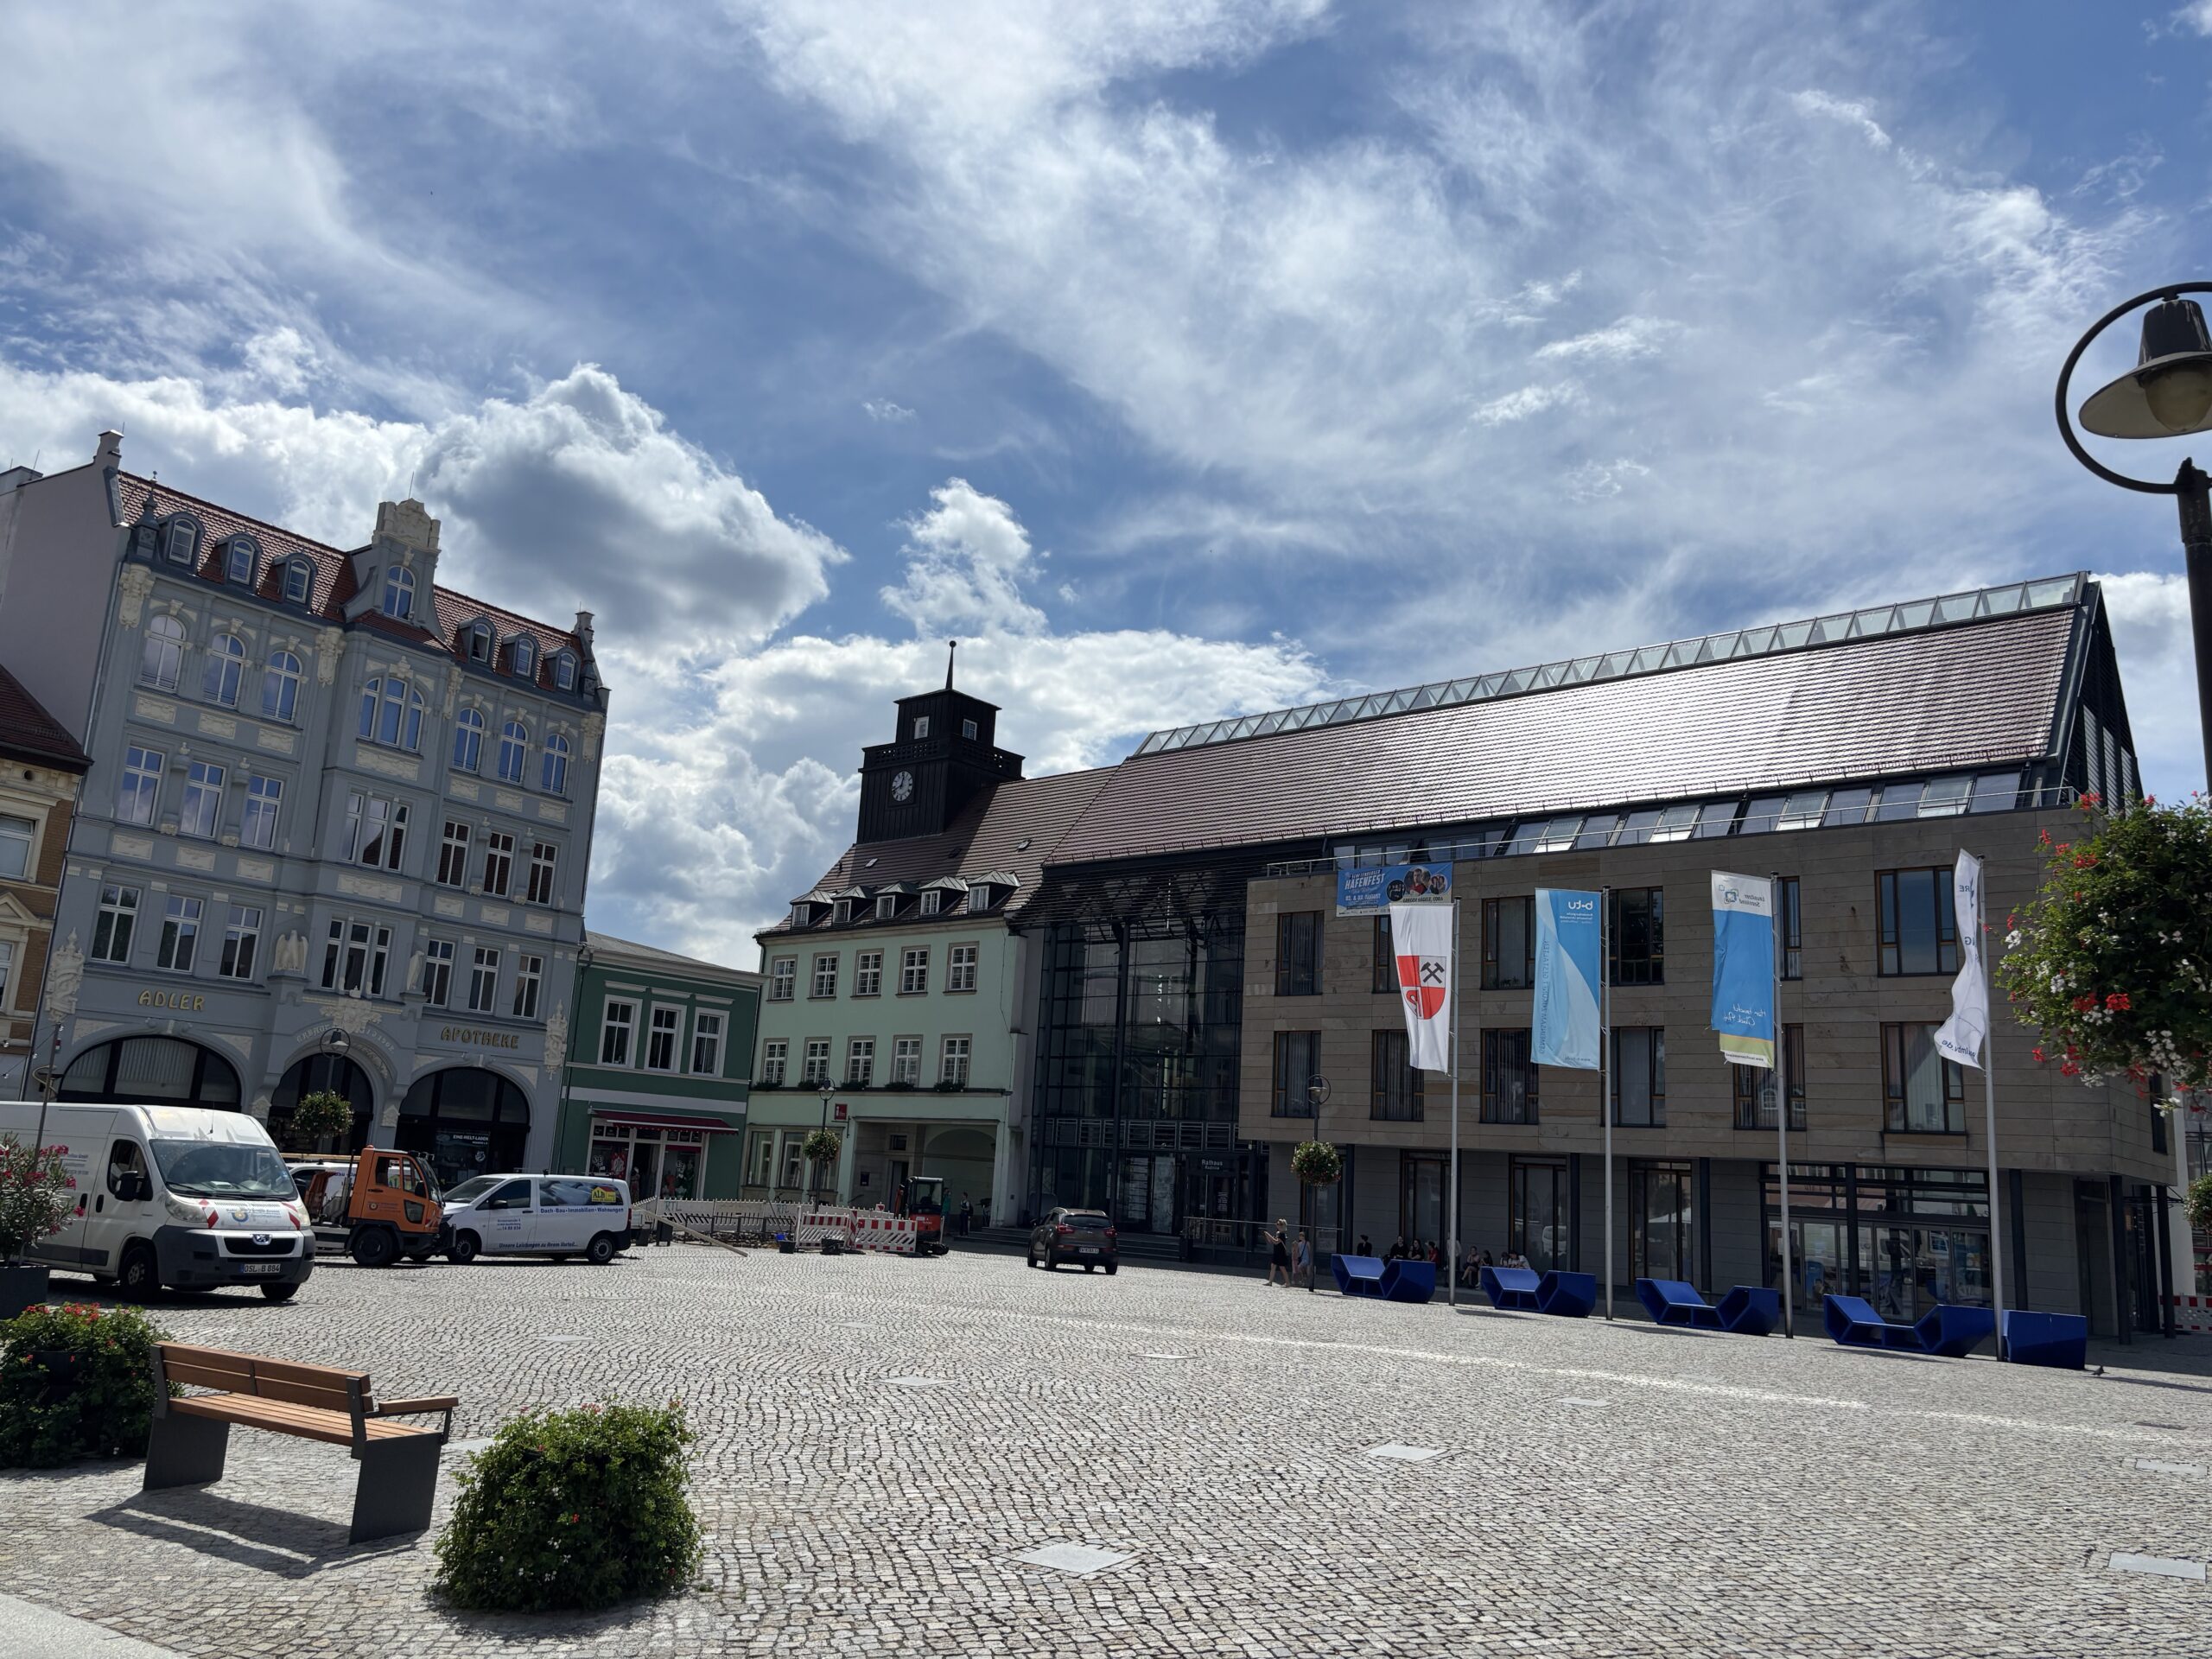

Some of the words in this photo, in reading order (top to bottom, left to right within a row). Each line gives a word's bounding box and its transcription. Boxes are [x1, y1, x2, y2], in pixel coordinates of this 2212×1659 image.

[1344, 873, 1385, 890] HAFENFEST
[138, 989, 206, 1011] ADLER
[441, 1026, 520, 1049] APOTHEKE
